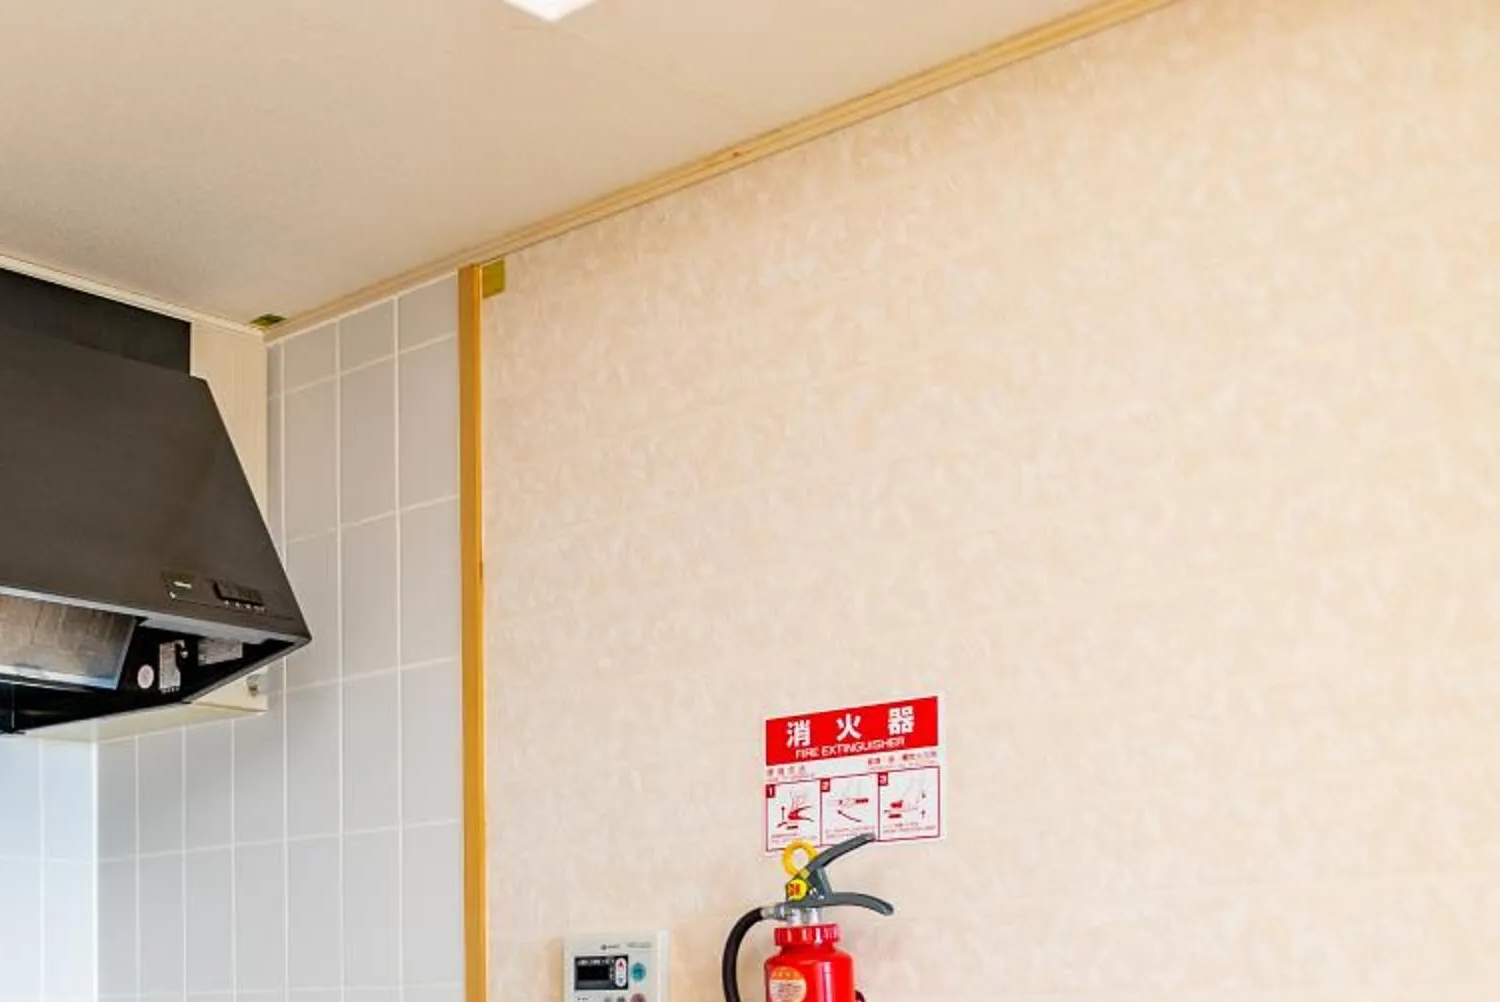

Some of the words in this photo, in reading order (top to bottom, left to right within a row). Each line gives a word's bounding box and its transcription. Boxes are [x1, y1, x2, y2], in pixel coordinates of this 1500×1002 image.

[786, 705, 915, 748] 消火器
[795, 746, 820, 760] FIRE
[821, 735, 906, 757] EXTINGUISHER
